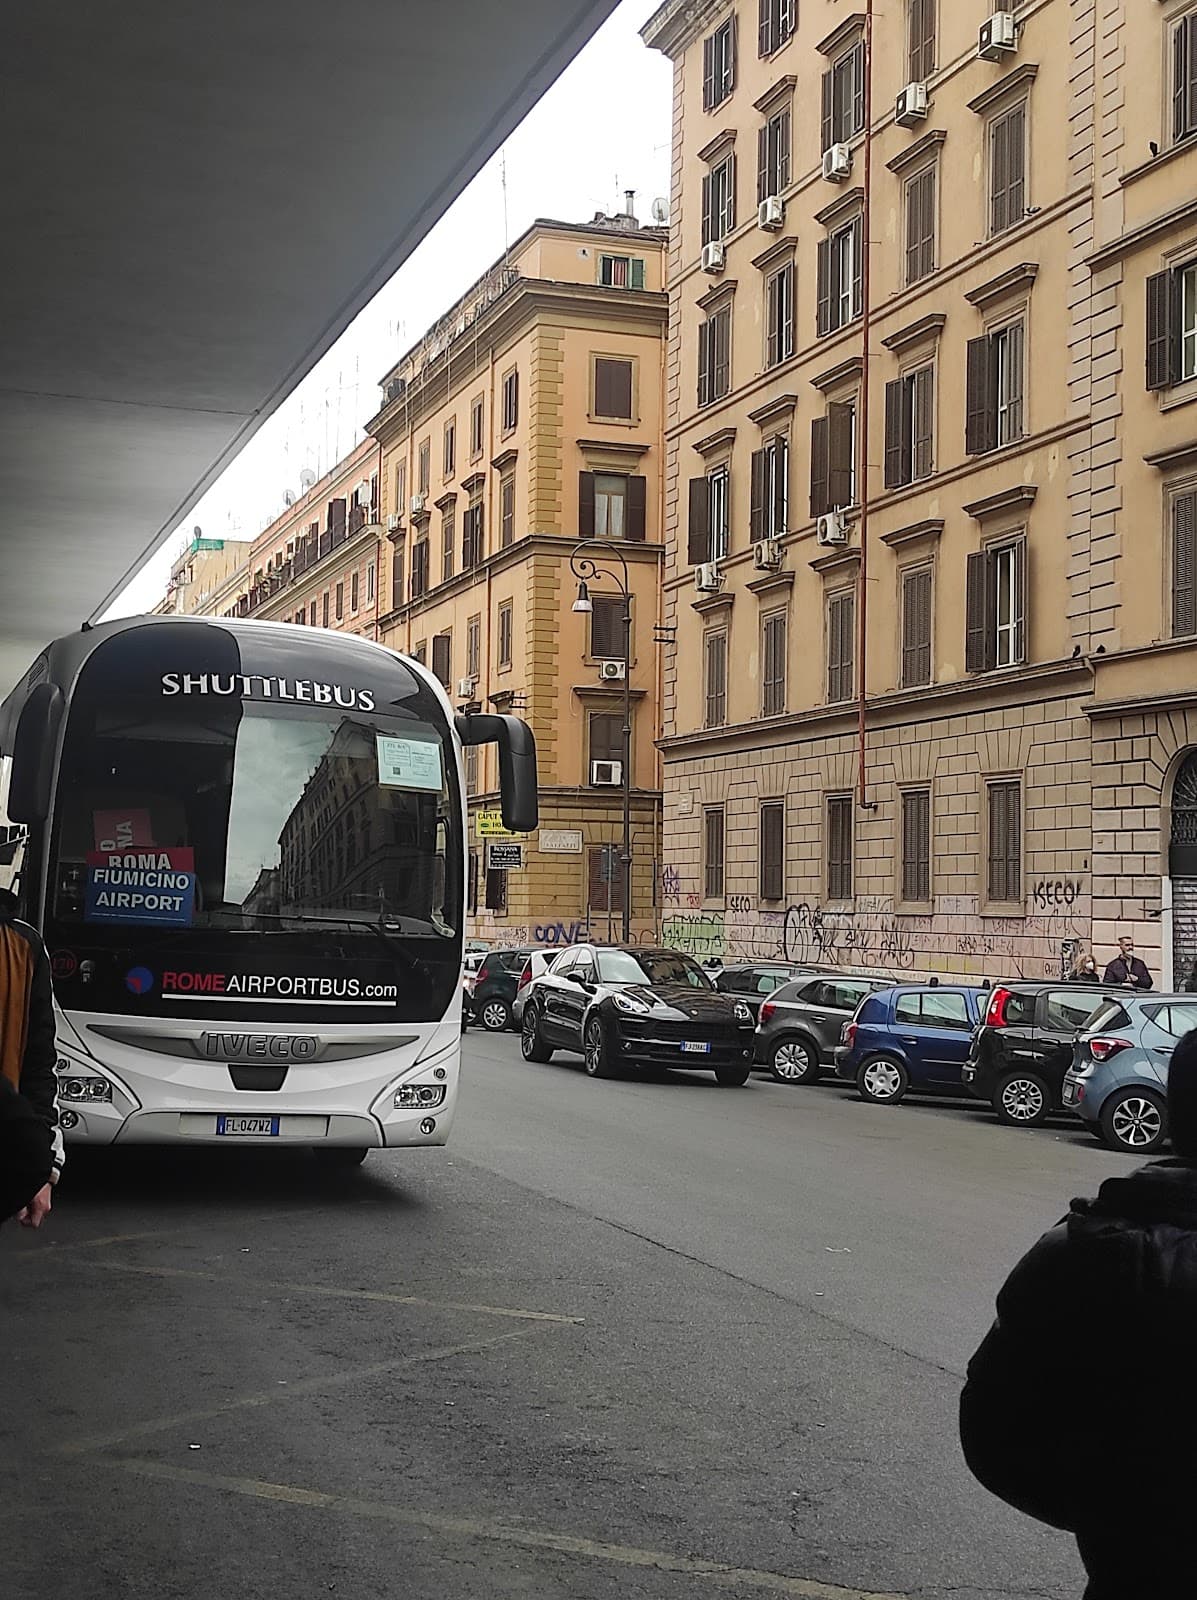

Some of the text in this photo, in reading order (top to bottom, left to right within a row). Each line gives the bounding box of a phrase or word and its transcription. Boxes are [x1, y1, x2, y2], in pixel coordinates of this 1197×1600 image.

[161, 673, 375, 712] SHUTTLEBUS
[107, 853, 172, 870] ROMA
[93, 868, 190, 890] FIUMICINO
[95, 891, 185, 912] AIRPORT
[161, 971, 398, 997] ROMEAIRPORTBUS.com
[205, 1032, 317, 1059] IVECO
